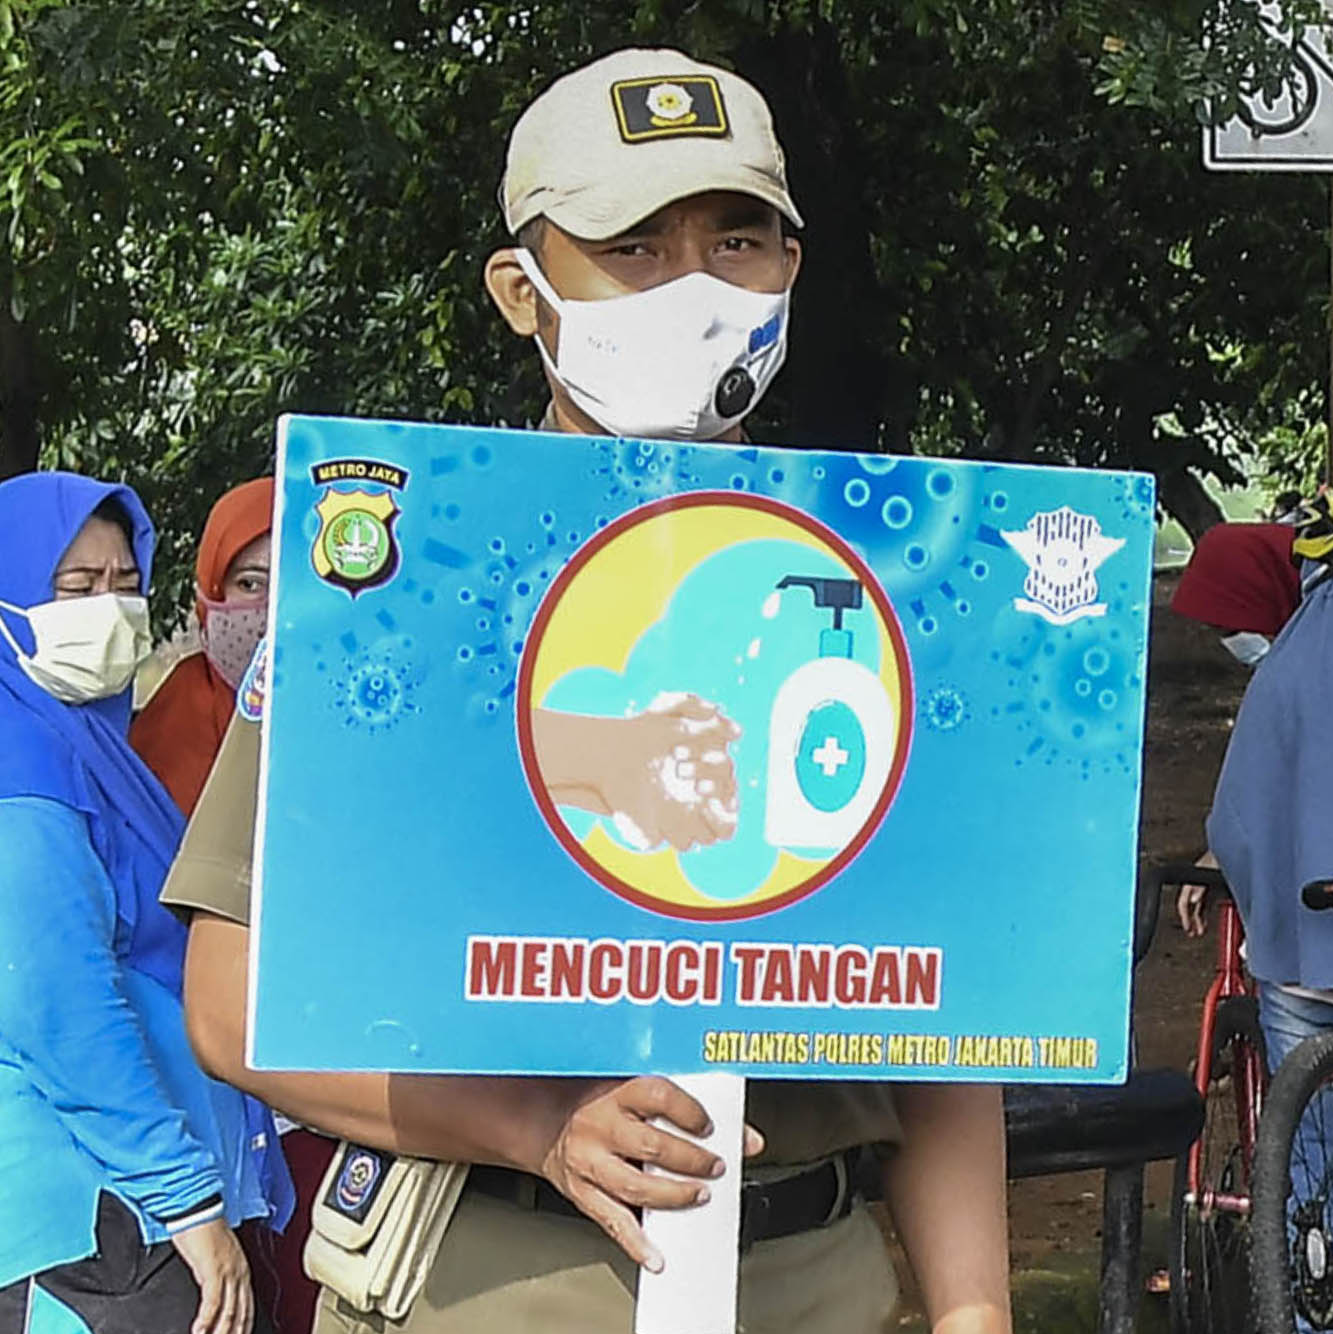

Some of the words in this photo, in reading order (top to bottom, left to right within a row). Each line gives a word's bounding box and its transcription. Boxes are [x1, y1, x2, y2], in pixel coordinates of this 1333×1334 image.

[318, 463, 367, 480] METRO
[367, 465, 400, 484] JAYA
[469, 940, 719, 1001] MENCUCI
[732, 946, 938, 1006] TANGAN
[703, 1031, 809, 1063] SATLANTAS
[812, 1033, 883, 1064] POLRES
[887, 1035, 950, 1065] METRO
[954, 1036, 1035, 1067] JAKARTA
[1037, 1037, 1098, 1068] TIMUR
